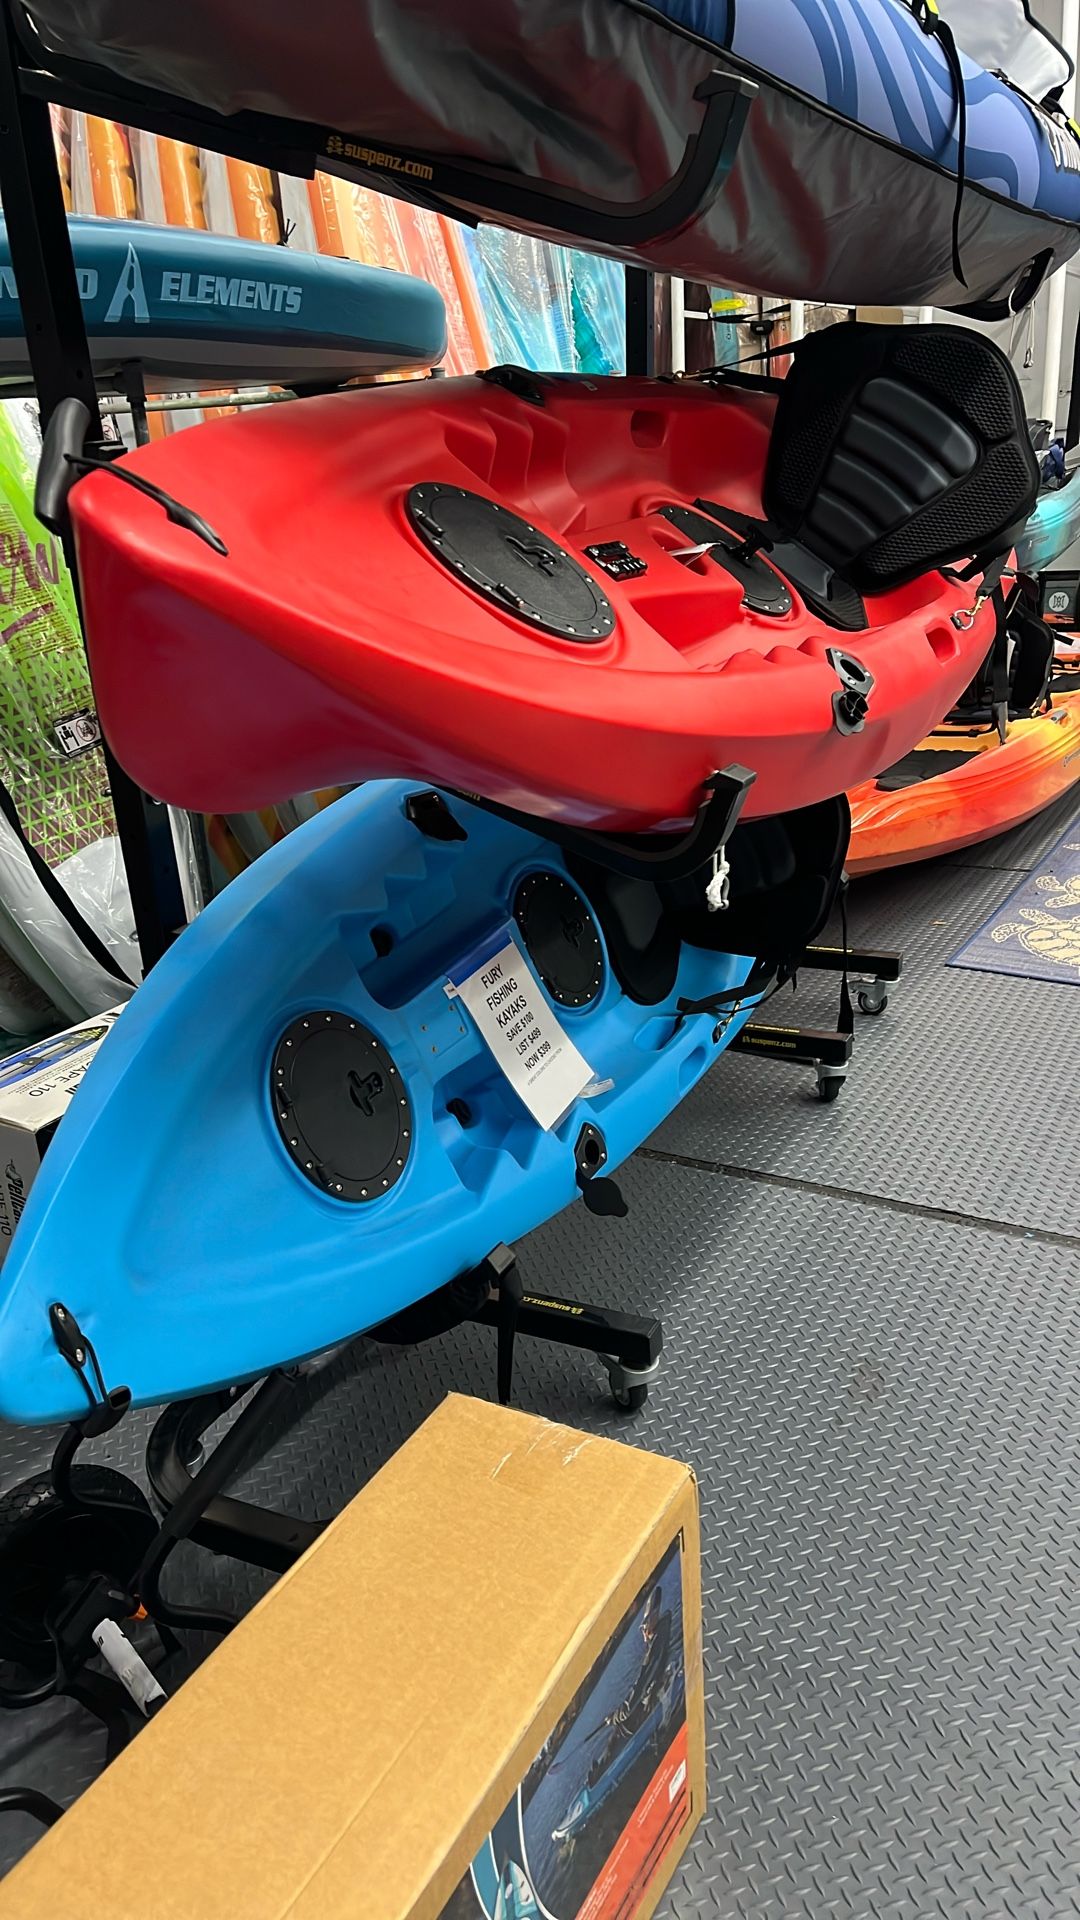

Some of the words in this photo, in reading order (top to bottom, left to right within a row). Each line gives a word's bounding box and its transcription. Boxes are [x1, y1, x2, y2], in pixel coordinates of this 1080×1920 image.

[344, 143, 434, 181] suspenz.com
[160, 271, 302, 314] ELEMENTS
[480, 963, 504, 989] FURY
[486, 977, 518, 1011] FISHING
[496, 995, 527, 1028] KAYAKS
[506, 1024, 523, 1042] SAVE
[521, 1011, 535, 1028] $100
[515, 1038, 530, 1056] LIST
[528, 1027, 542, 1044] $499
[524, 1052, 540, 1071] NOW
[537, 1041, 551, 1058] $399
[28, 1082, 57, 1097] 110
